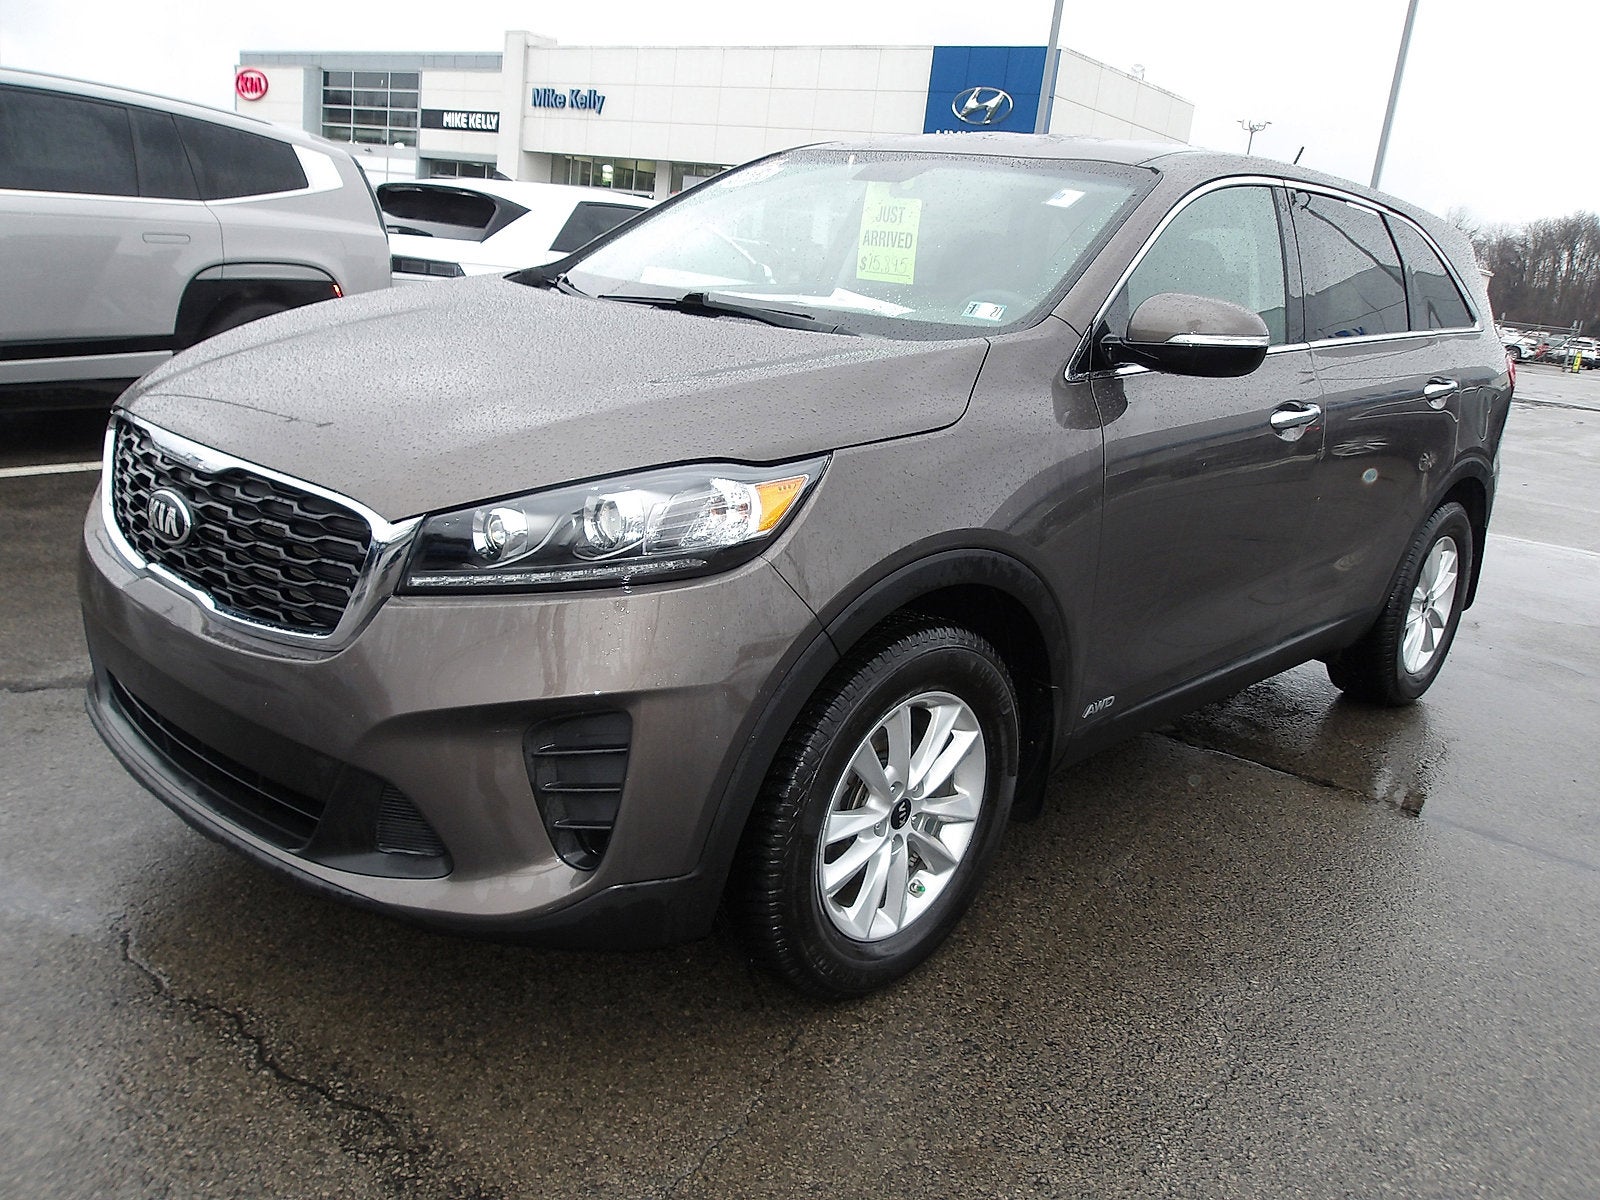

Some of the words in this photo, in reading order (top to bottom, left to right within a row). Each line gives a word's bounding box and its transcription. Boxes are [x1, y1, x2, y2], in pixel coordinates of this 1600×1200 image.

[238, 75, 264, 94] KIA
[531, 88, 566, 109] Mike
[568, 89, 606, 115] Kelly
[443, 111, 468, 128] MIKE
[468, 113, 499, 130] KELLY
[874, 206, 906, 223] JUST
[862, 229, 913, 249] ARRIVED
[149, 497, 180, 538] KIA
[1082, 695, 1115, 719] AWD
